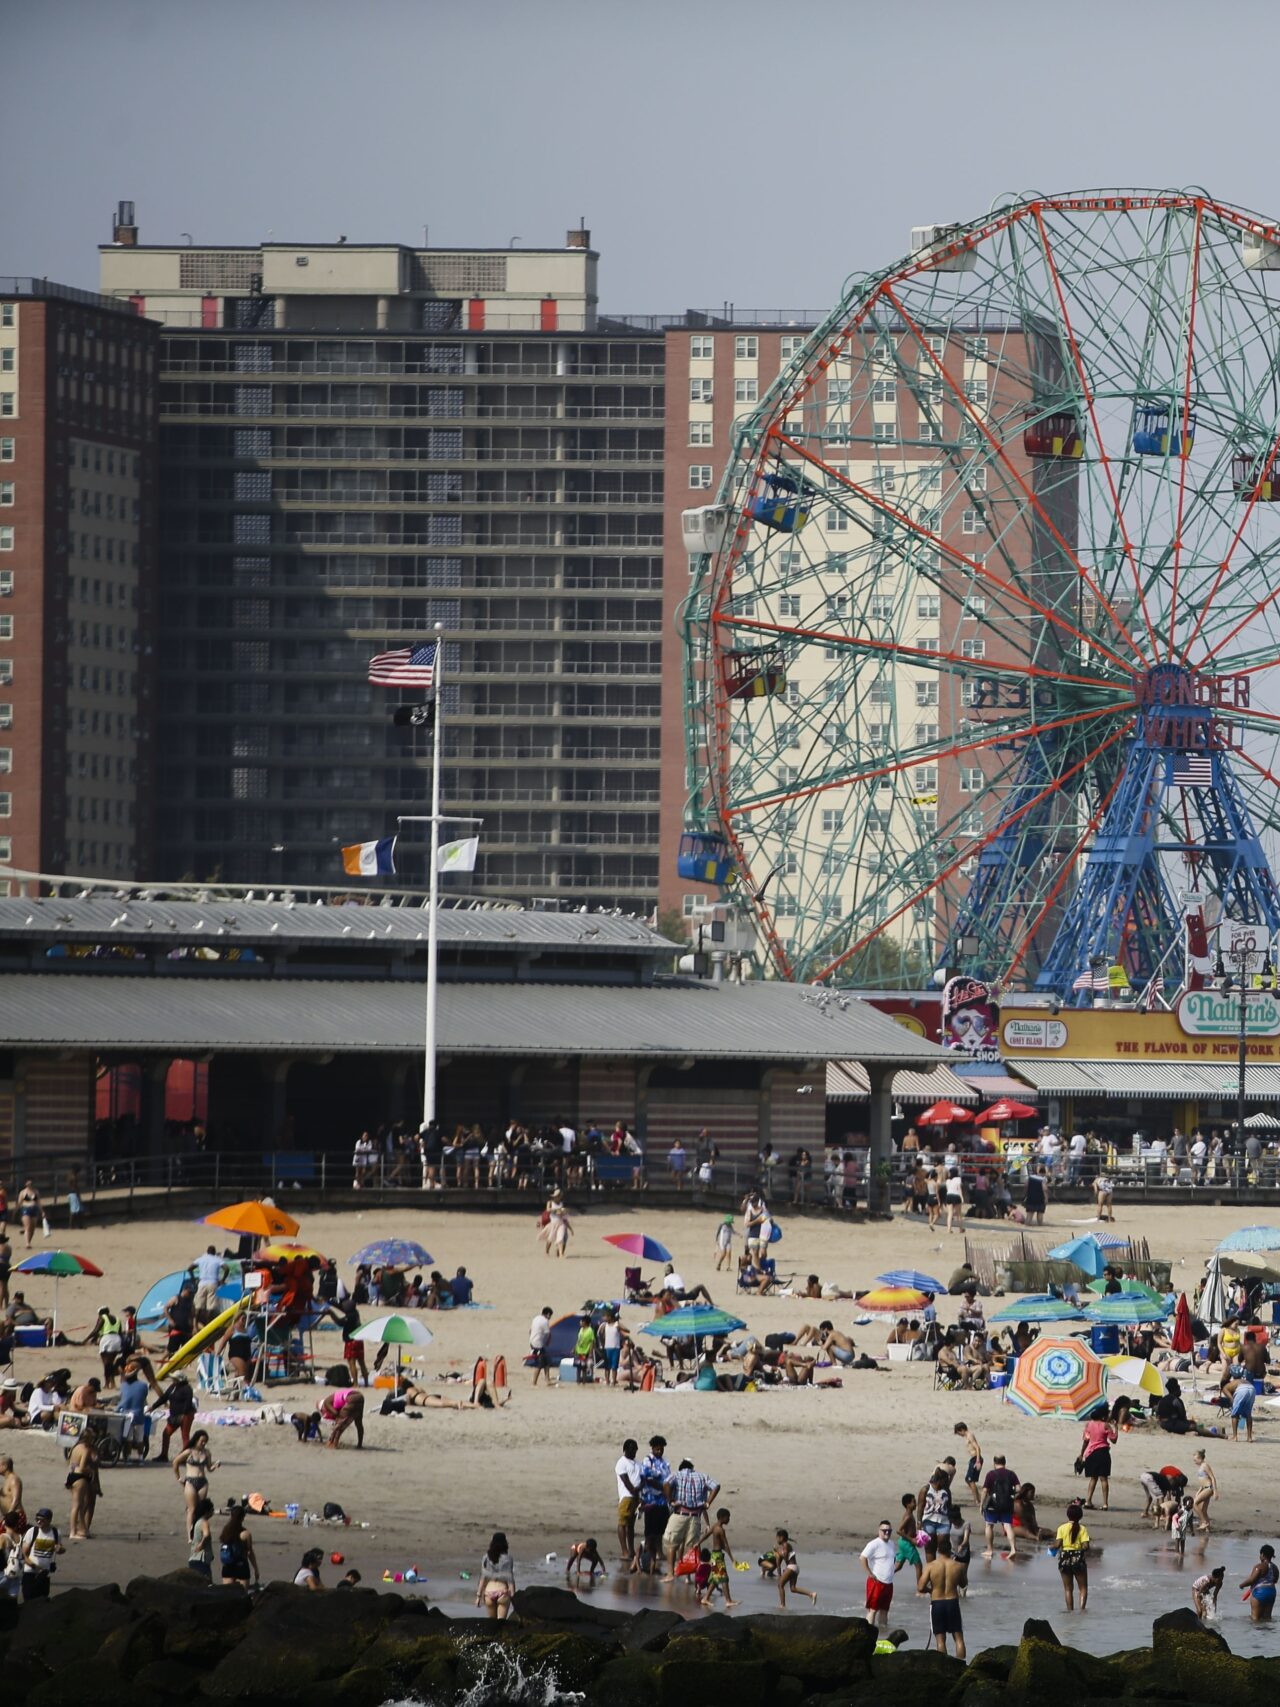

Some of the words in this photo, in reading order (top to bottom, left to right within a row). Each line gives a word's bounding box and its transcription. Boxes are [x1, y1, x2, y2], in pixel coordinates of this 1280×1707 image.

[1134, 672, 1250, 707] WONDER
[1144, 714, 1243, 750] WHEEL
[1187, 993, 1280, 1022] Nathan's
[1010, 1021, 1042, 1032] Nathan's
[976, 1050, 1000, 1062] SHOP
[1115, 1042, 1139, 1053] THE
[1144, 1042, 1188, 1054] FLAVOR
[1193, 1043, 1208, 1054] OF
[1212, 1043, 1240, 1055] NEW
[1244, 1044, 1274, 1055] YORK
